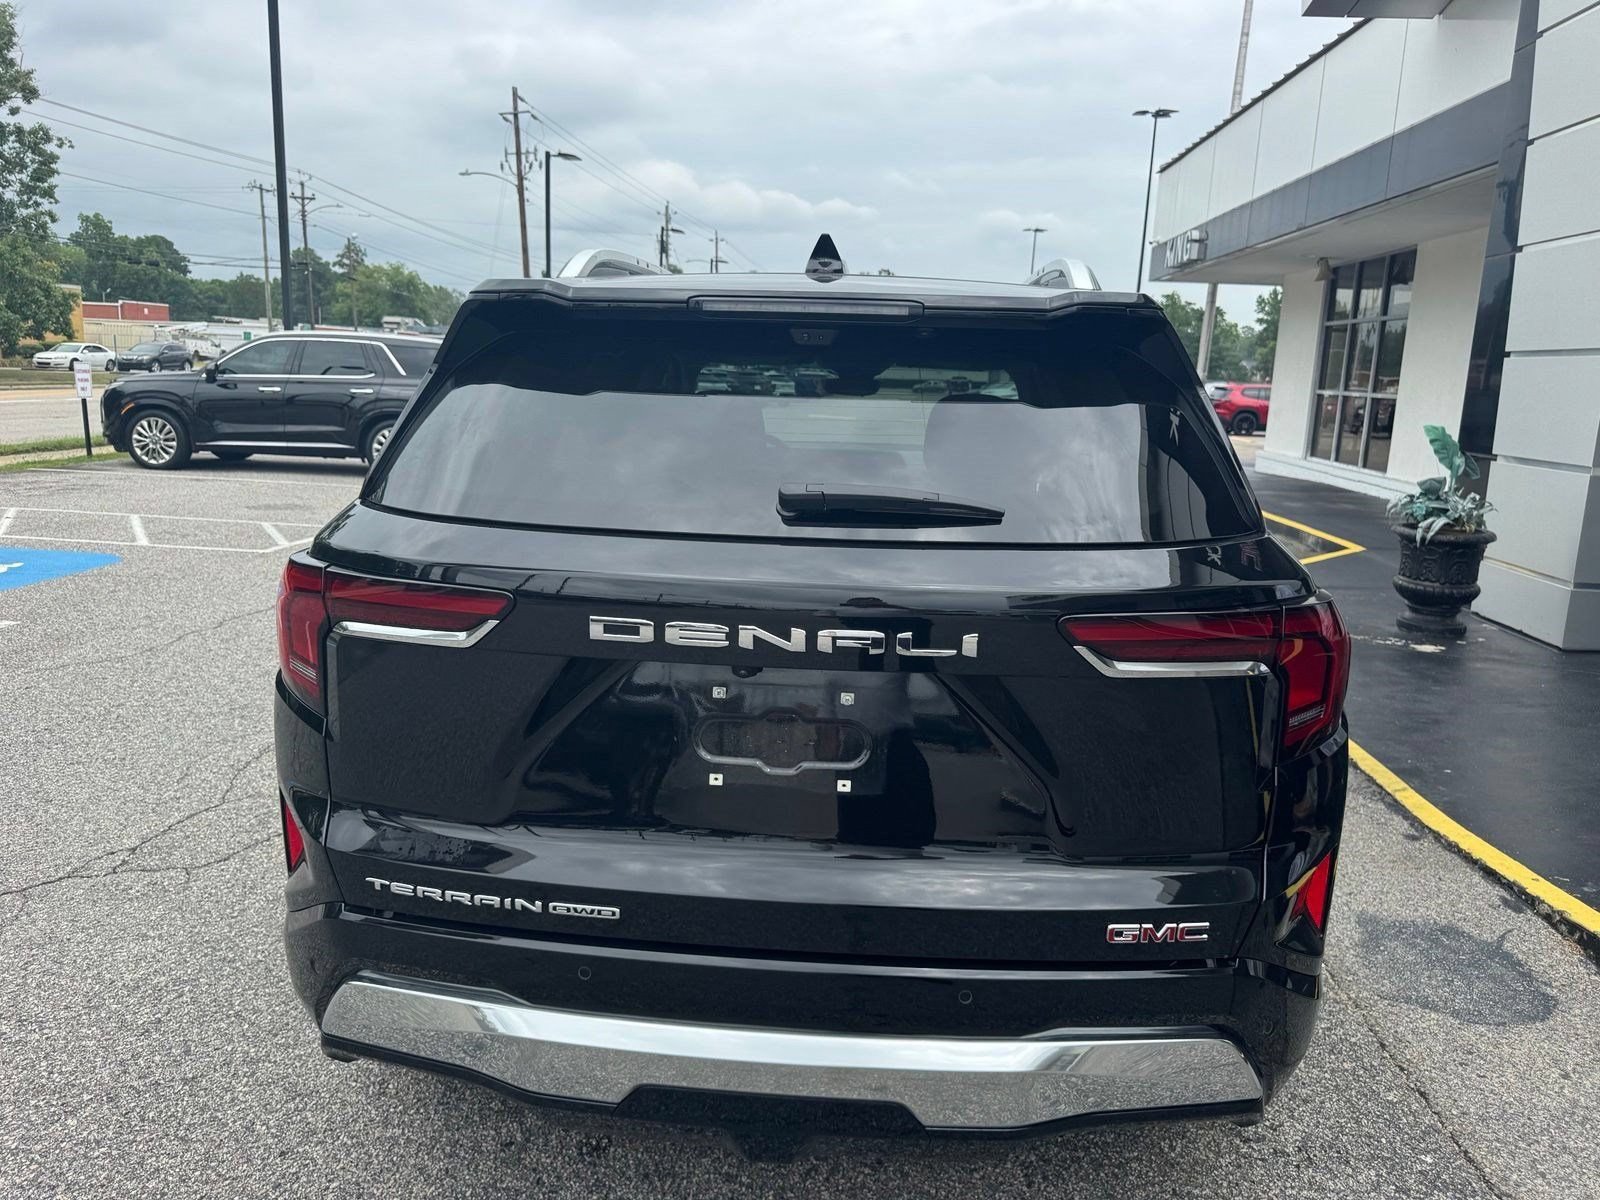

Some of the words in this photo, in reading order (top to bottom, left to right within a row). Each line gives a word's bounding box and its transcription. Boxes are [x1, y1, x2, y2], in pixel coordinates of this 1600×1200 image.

[589, 615, 979, 658] DENALI
[365, 877, 542, 913] TERRAIN
[549, 902, 620, 919] AWD
[1107, 921, 1210, 944] GMC
